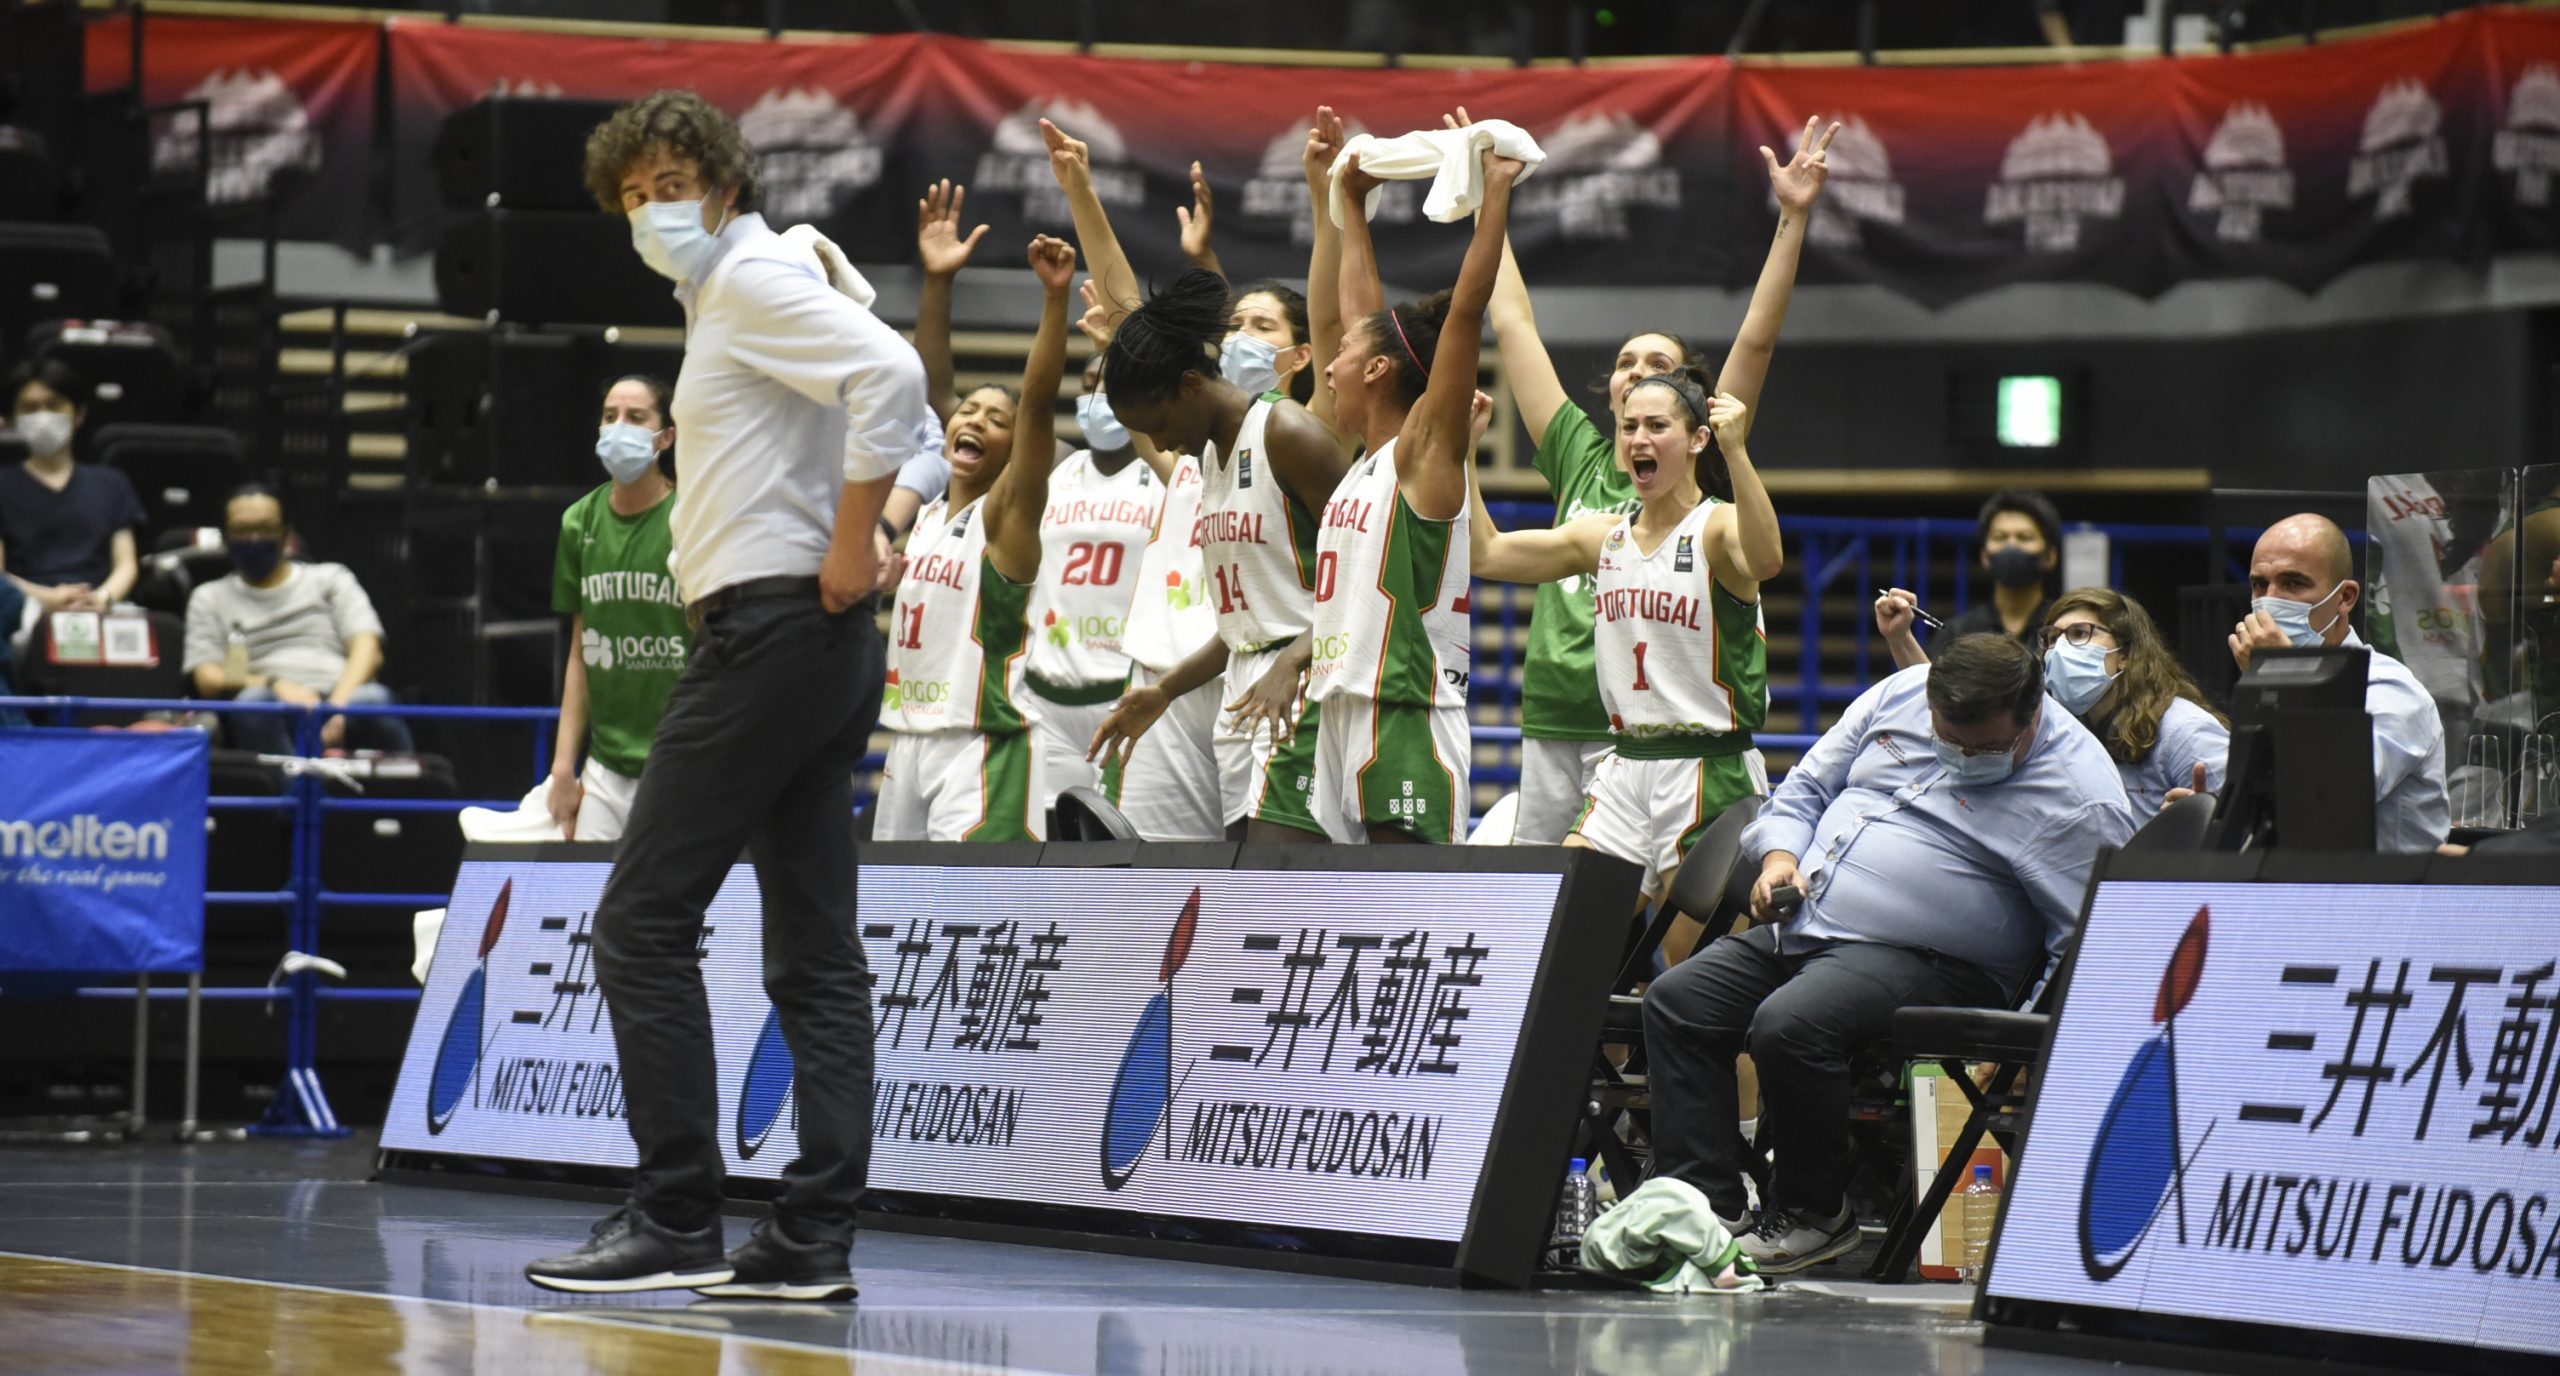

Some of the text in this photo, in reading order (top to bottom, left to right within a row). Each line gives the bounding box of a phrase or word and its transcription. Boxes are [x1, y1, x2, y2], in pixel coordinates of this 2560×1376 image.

[1201, 510, 1267, 549] RTUGAL
[1061, 541, 1125, 586] 20
[1215, 562, 1250, 615] 14
[1077, 615, 1129, 643] JOG
[1594, 588, 1701, 632] PORTUGAL
[616, 635, 686, 665] JOGOS
[1632, 641, 1650, 691] 1
[901, 679, 951, 703] OGOS
[1210, 927, 1489, 1078] 三井不動産
[2238, 957, 2560, 1150] 三井不動
[486, 1056, 628, 1119] MITSUI FUDO
[894, 1082, 1026, 1147] FUDOSAN
[1182, 1101, 1443, 1180] MITSUI FUDOSAN
[2203, 1171, 2560, 1279] MITSUI FUDOS
